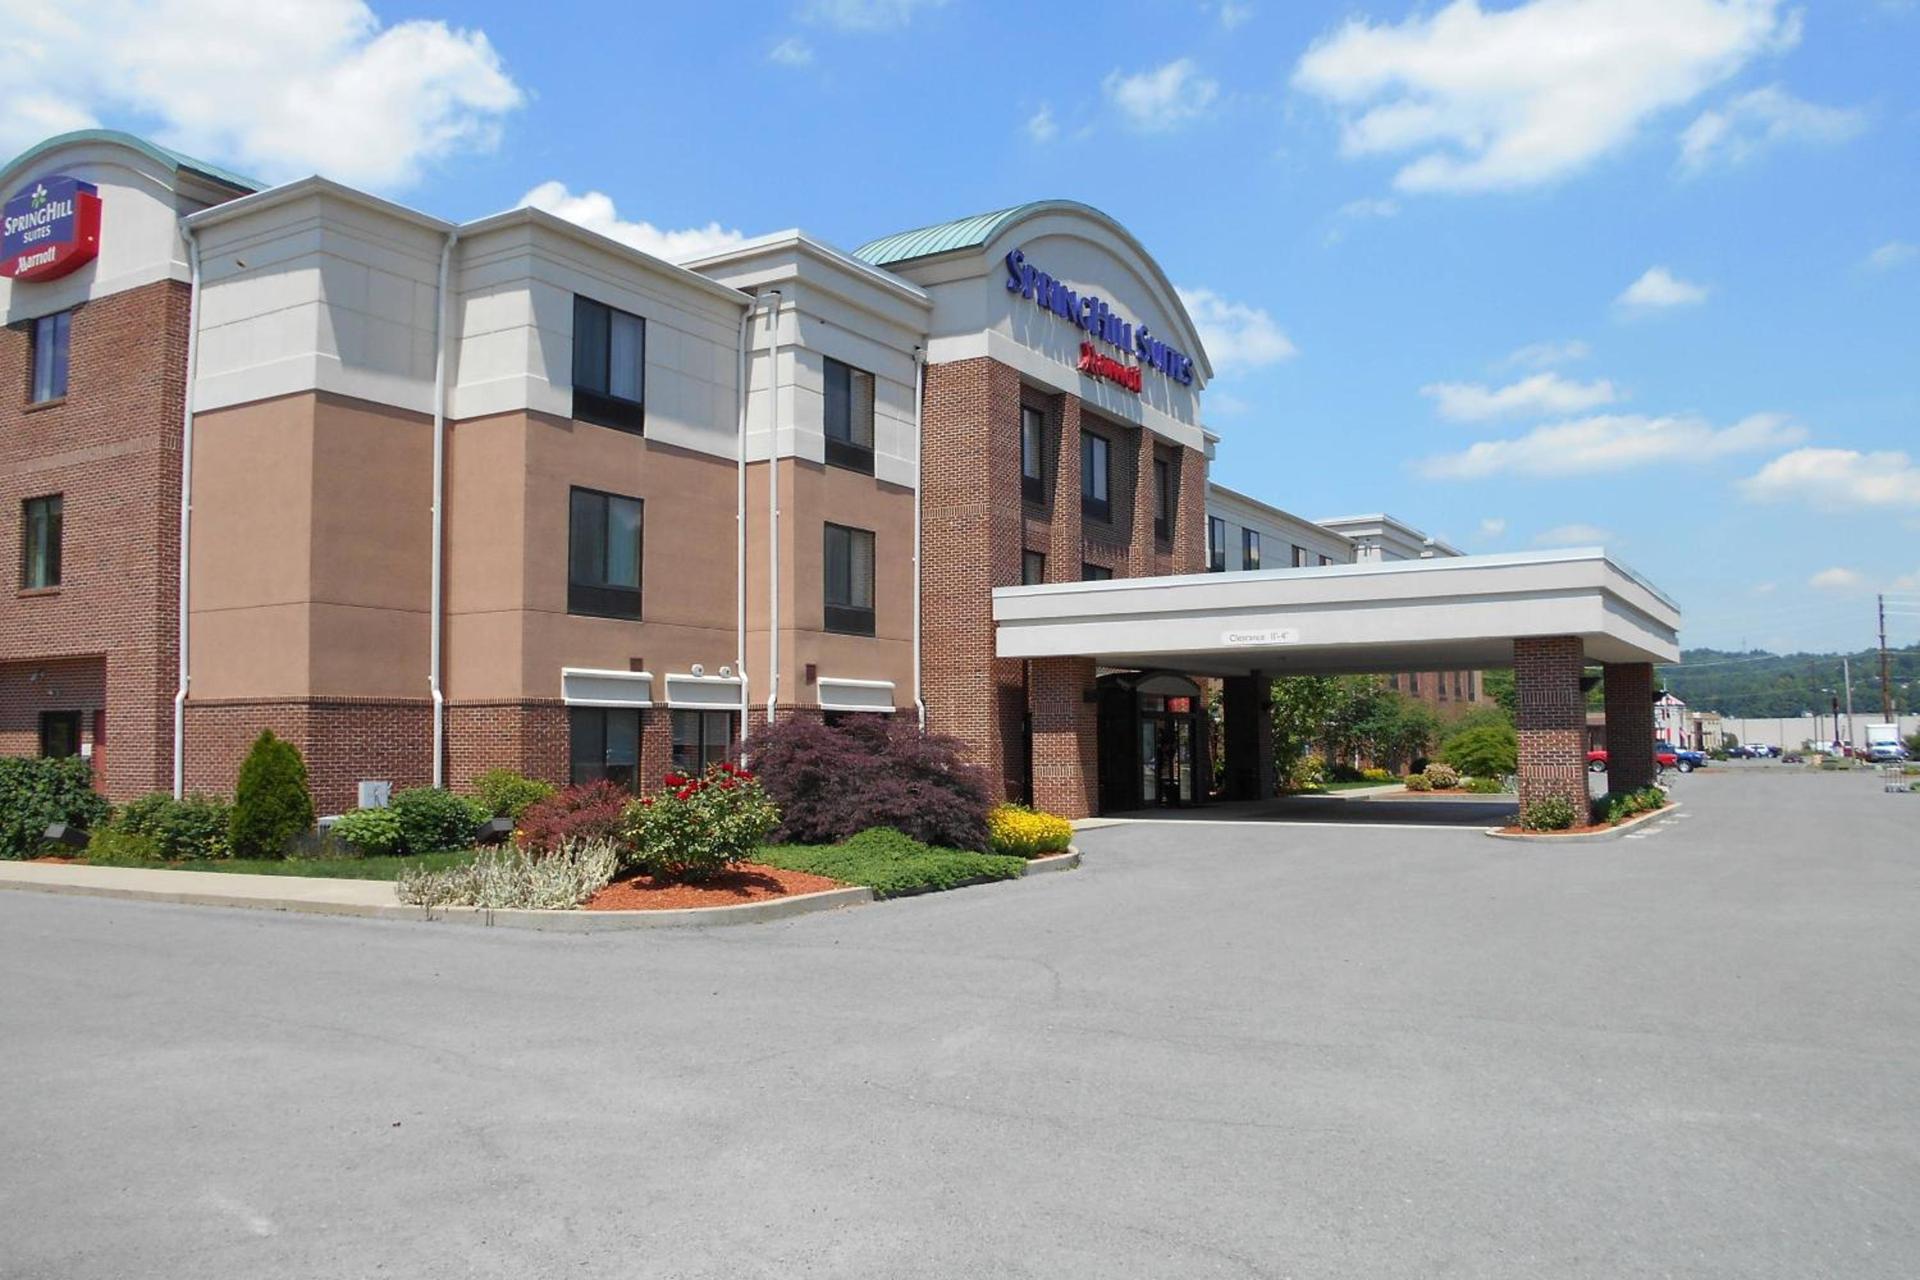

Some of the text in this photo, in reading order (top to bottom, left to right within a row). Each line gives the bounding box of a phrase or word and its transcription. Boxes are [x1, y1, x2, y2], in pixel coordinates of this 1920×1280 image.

[4, 199, 74, 236] SPRINGHILL
[23, 225, 51, 244] SUITES
[15, 245, 57, 275] Marriott
[1005, 248, 1193, 386] SPRINGHILL SUITES
